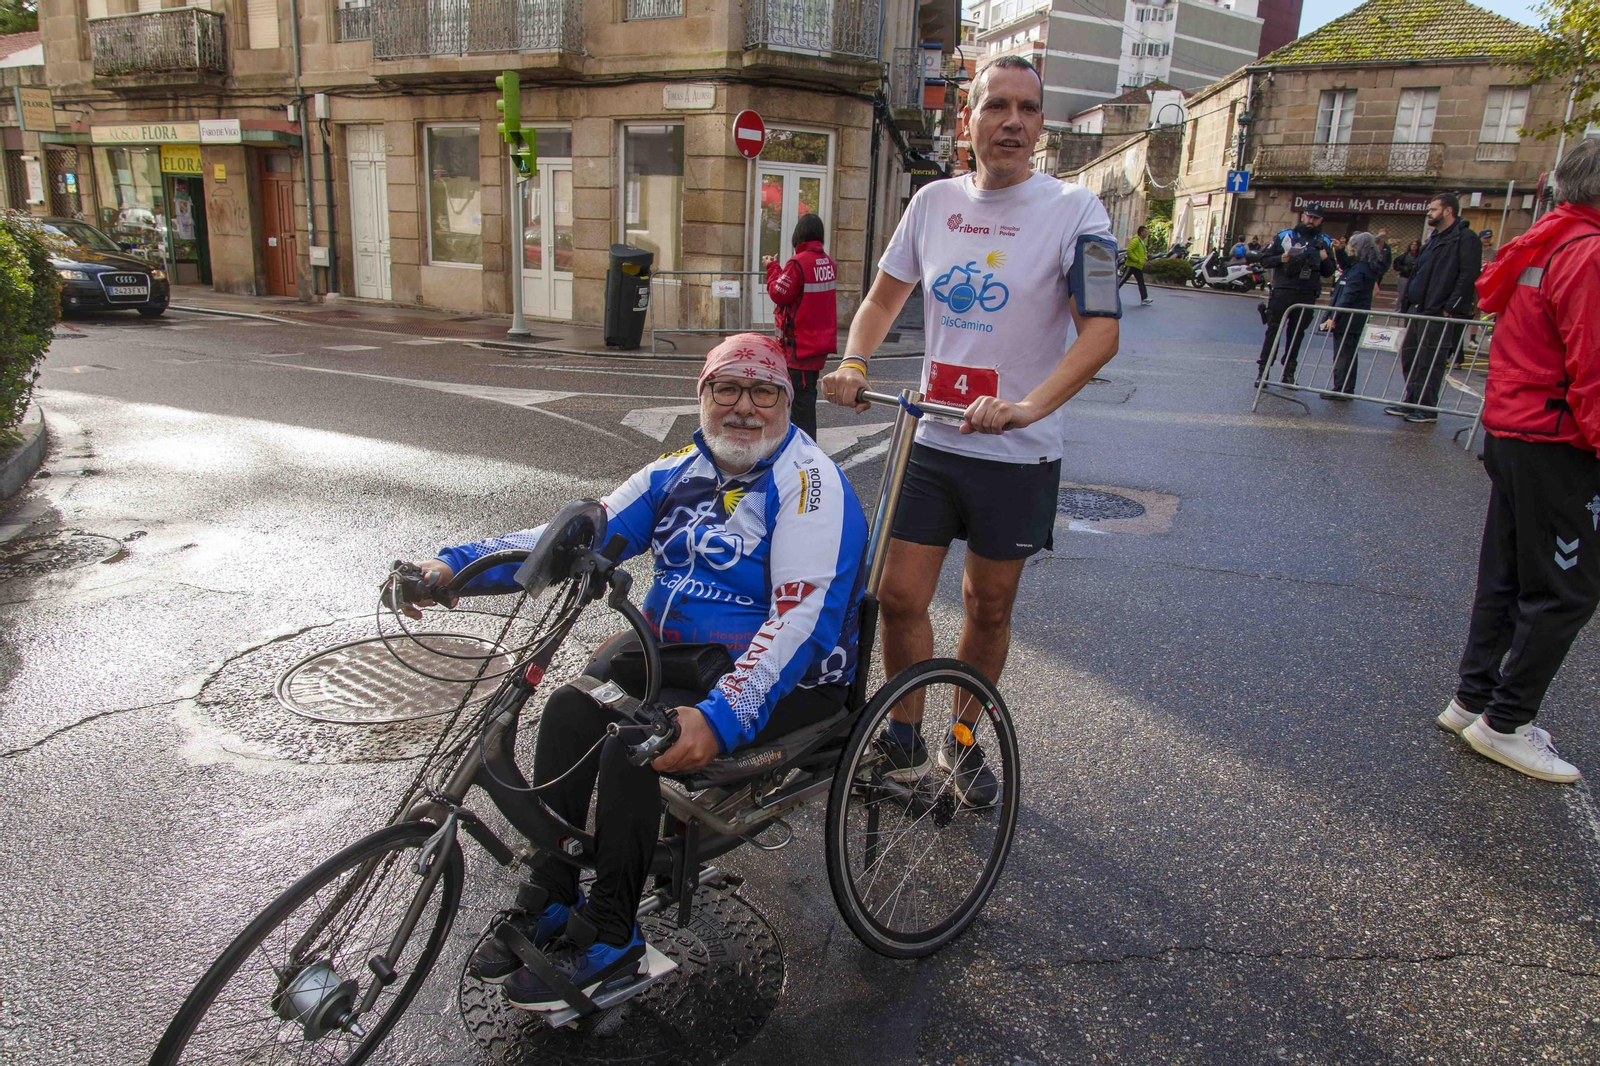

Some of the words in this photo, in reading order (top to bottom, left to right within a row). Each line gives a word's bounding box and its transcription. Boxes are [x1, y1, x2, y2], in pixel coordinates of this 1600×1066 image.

[22, 100, 50, 108] FLORA
[141, 126, 178, 140] FLORA
[163, 156, 203, 171] FLORA
[959, 224, 990, 235] ribera
[813, 265, 835, 282] VODEA
[941, 315, 993, 333] DisCamino
[954, 374, 969, 395] 4
[809, 467, 822, 513] RODOSA
[710, 630, 756, 641] Hospit
